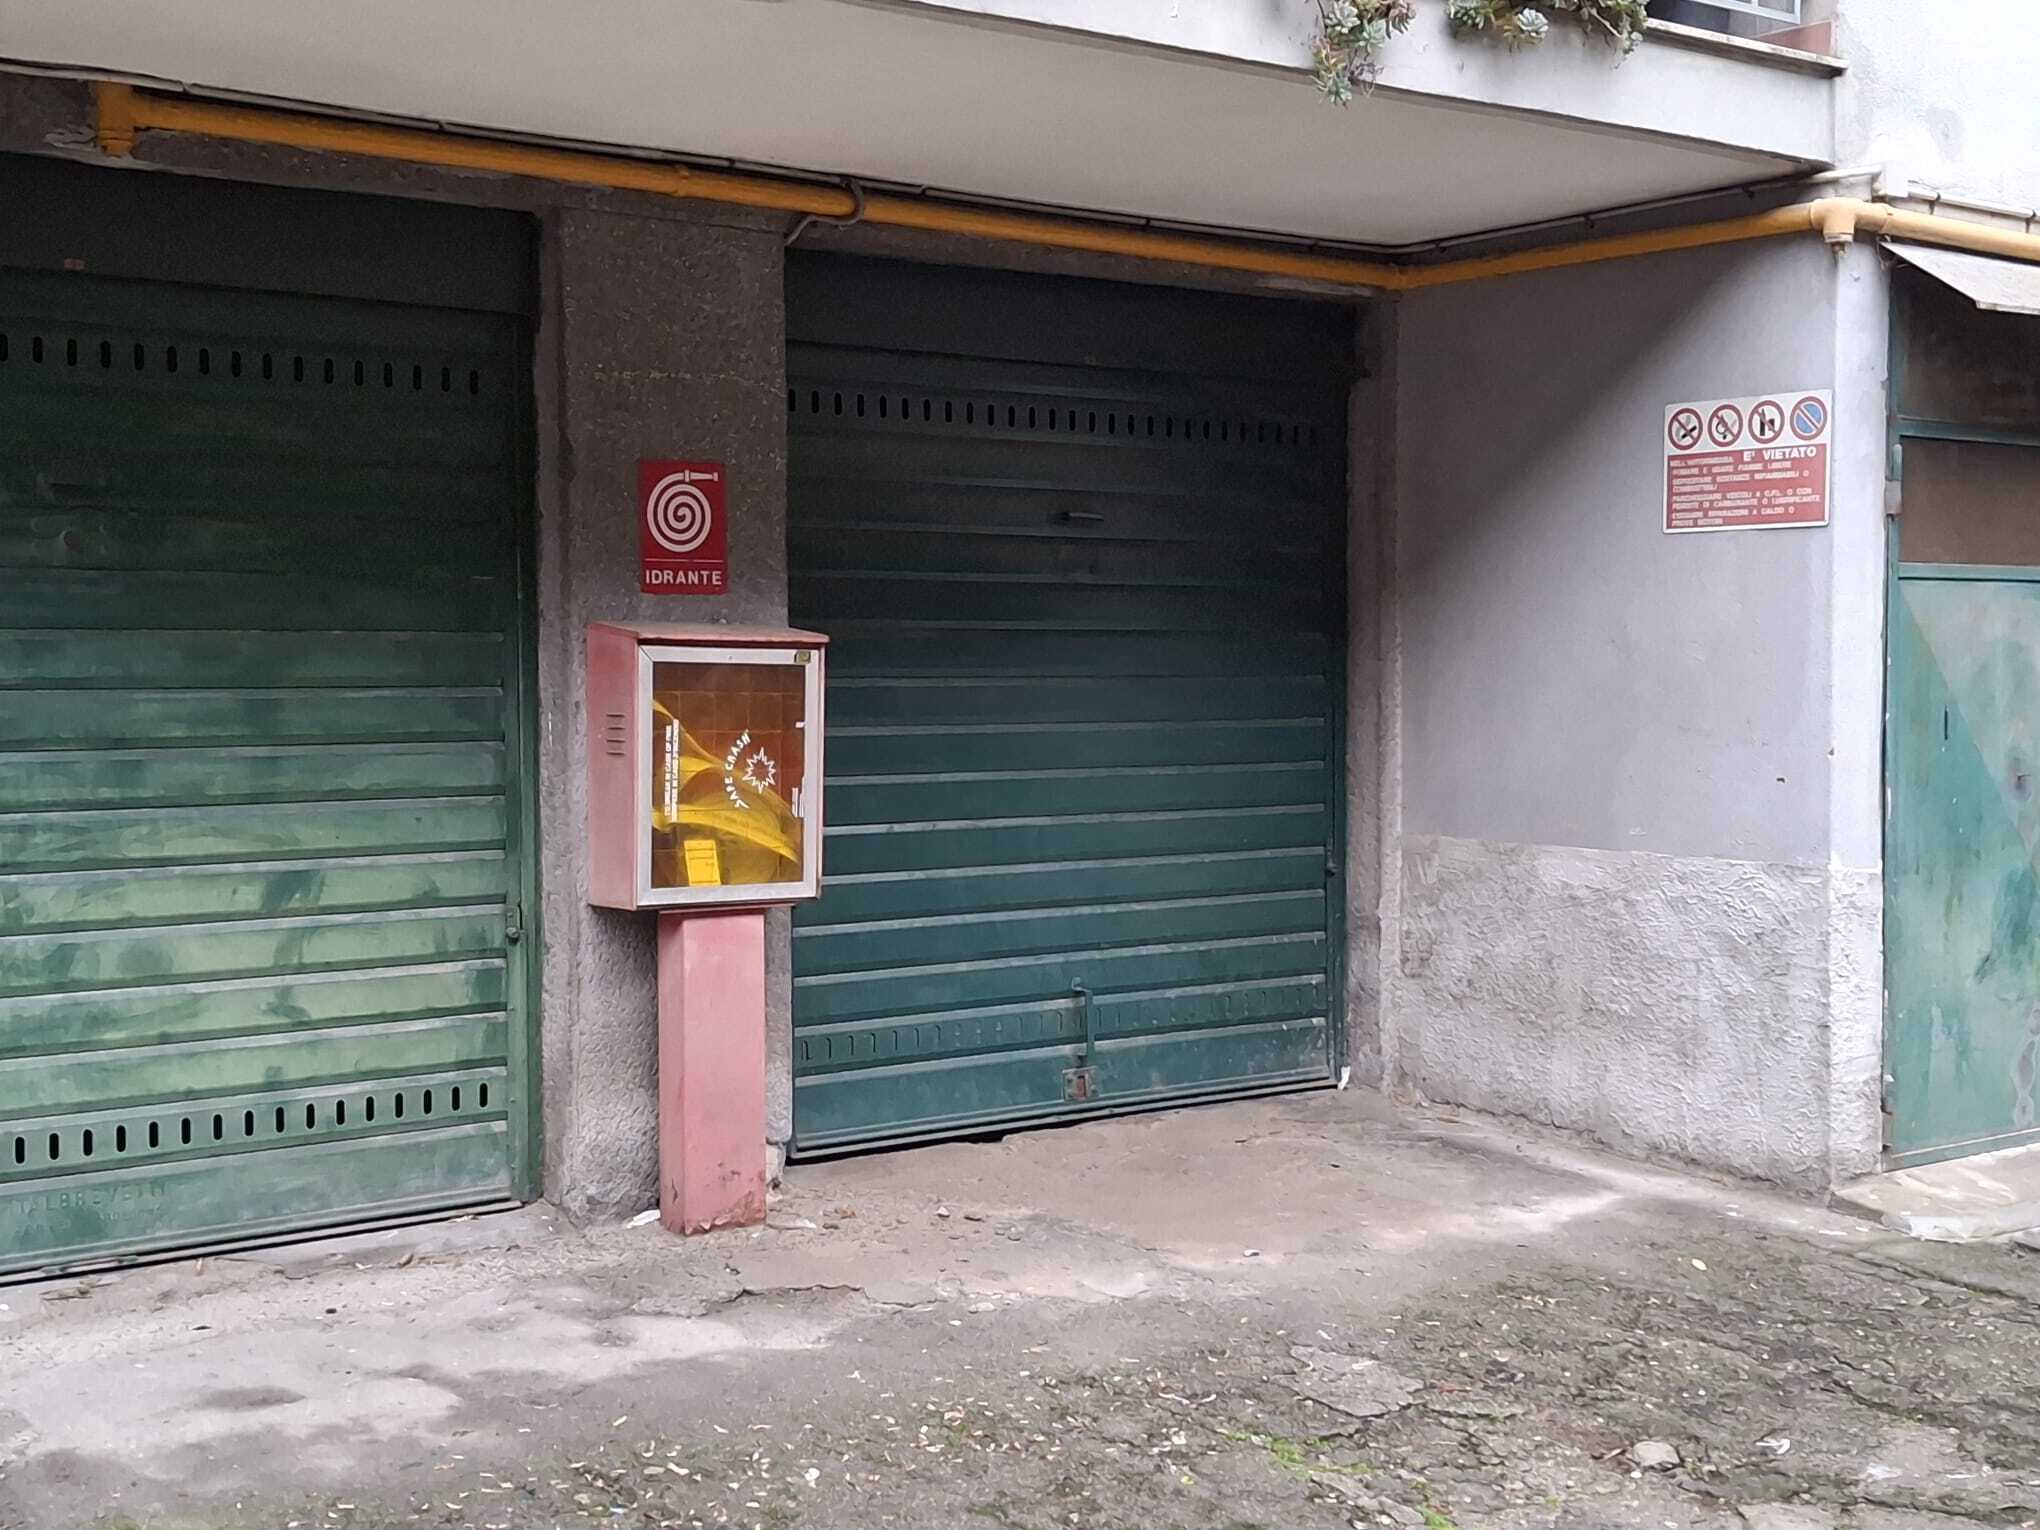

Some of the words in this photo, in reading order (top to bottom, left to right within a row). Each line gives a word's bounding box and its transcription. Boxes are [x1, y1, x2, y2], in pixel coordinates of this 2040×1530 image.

[1763, 446, 1817, 460] VIETATO
[645, 569, 723, 585] IDRANTE
[724, 732, 751, 771] CRASH
